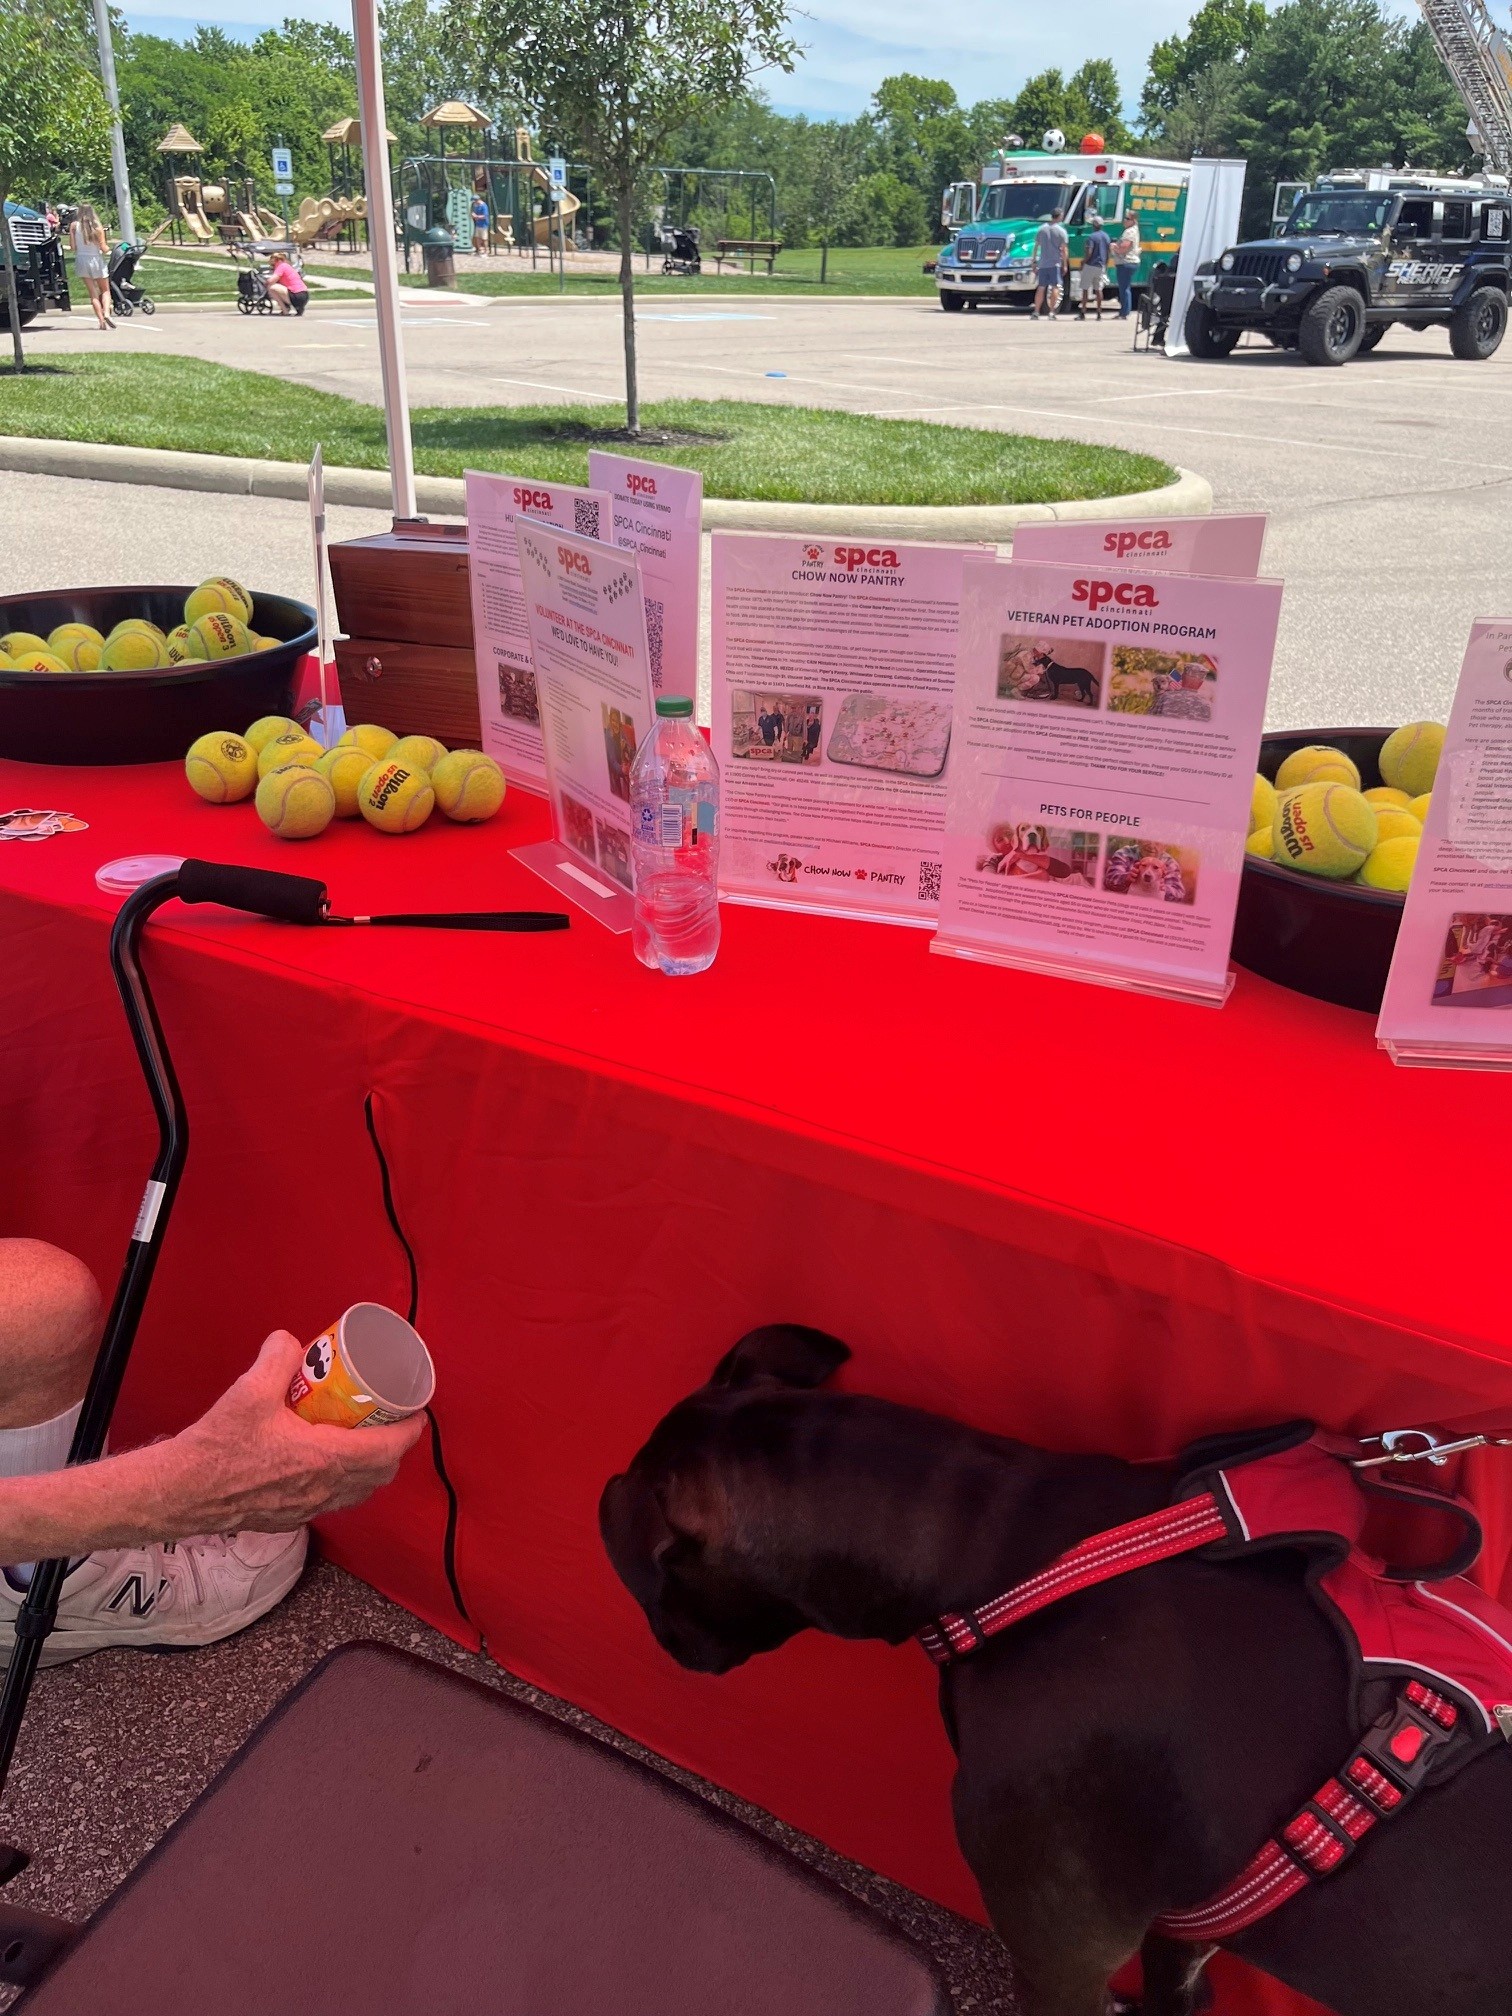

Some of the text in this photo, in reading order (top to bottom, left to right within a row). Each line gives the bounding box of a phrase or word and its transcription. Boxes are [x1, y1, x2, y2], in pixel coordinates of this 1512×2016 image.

[1385, 263, 1465, 278] SHERIFF
[626, 473, 658, 495] spca
[513, 487, 554, 512] spca
[656, 502, 672, 514] VENMO
[613, 514, 672, 542] SPCA Cincinnati
[1103, 530, 1172, 558] spca
[1126, 550, 1167, 558] cincinnati
[557, 546, 592, 576] spca
[801, 560, 824, 569] PANTRY
[834, 547, 901, 572] spca
[791, 570, 905, 587] CHOW NOW PANTRY
[1071, 579, 1160, 611] spca
[1100, 606, 1153, 616] cincinnati
[215, 614, 237, 649] Wilson
[535, 604, 635, 658] VOLUNTEER AT THE SPCA CINCINNATI
[1007, 610, 1216, 639] VETERAN PET ADOPTION PROGRAM
[1486, 632, 1495, 640] In
[493, 646, 525, 663] CORPORATE
[565, 632, 580, 648] LOVE
[580, 639, 588, 652] TO
[588, 643, 604, 660] HAVE
[750, 747, 773, 756] spca
[388, 764, 398, 774] us
[372, 774, 389, 799] open
[376, 770, 410, 810] Wilson
[1040, 803, 1141, 827] PETS FOR PEOPLE
[1281, 800, 1302, 859] Wilson
[1300, 836, 1314, 850] us
[804, 865, 906, 885] CHOW NOW PANTRY
